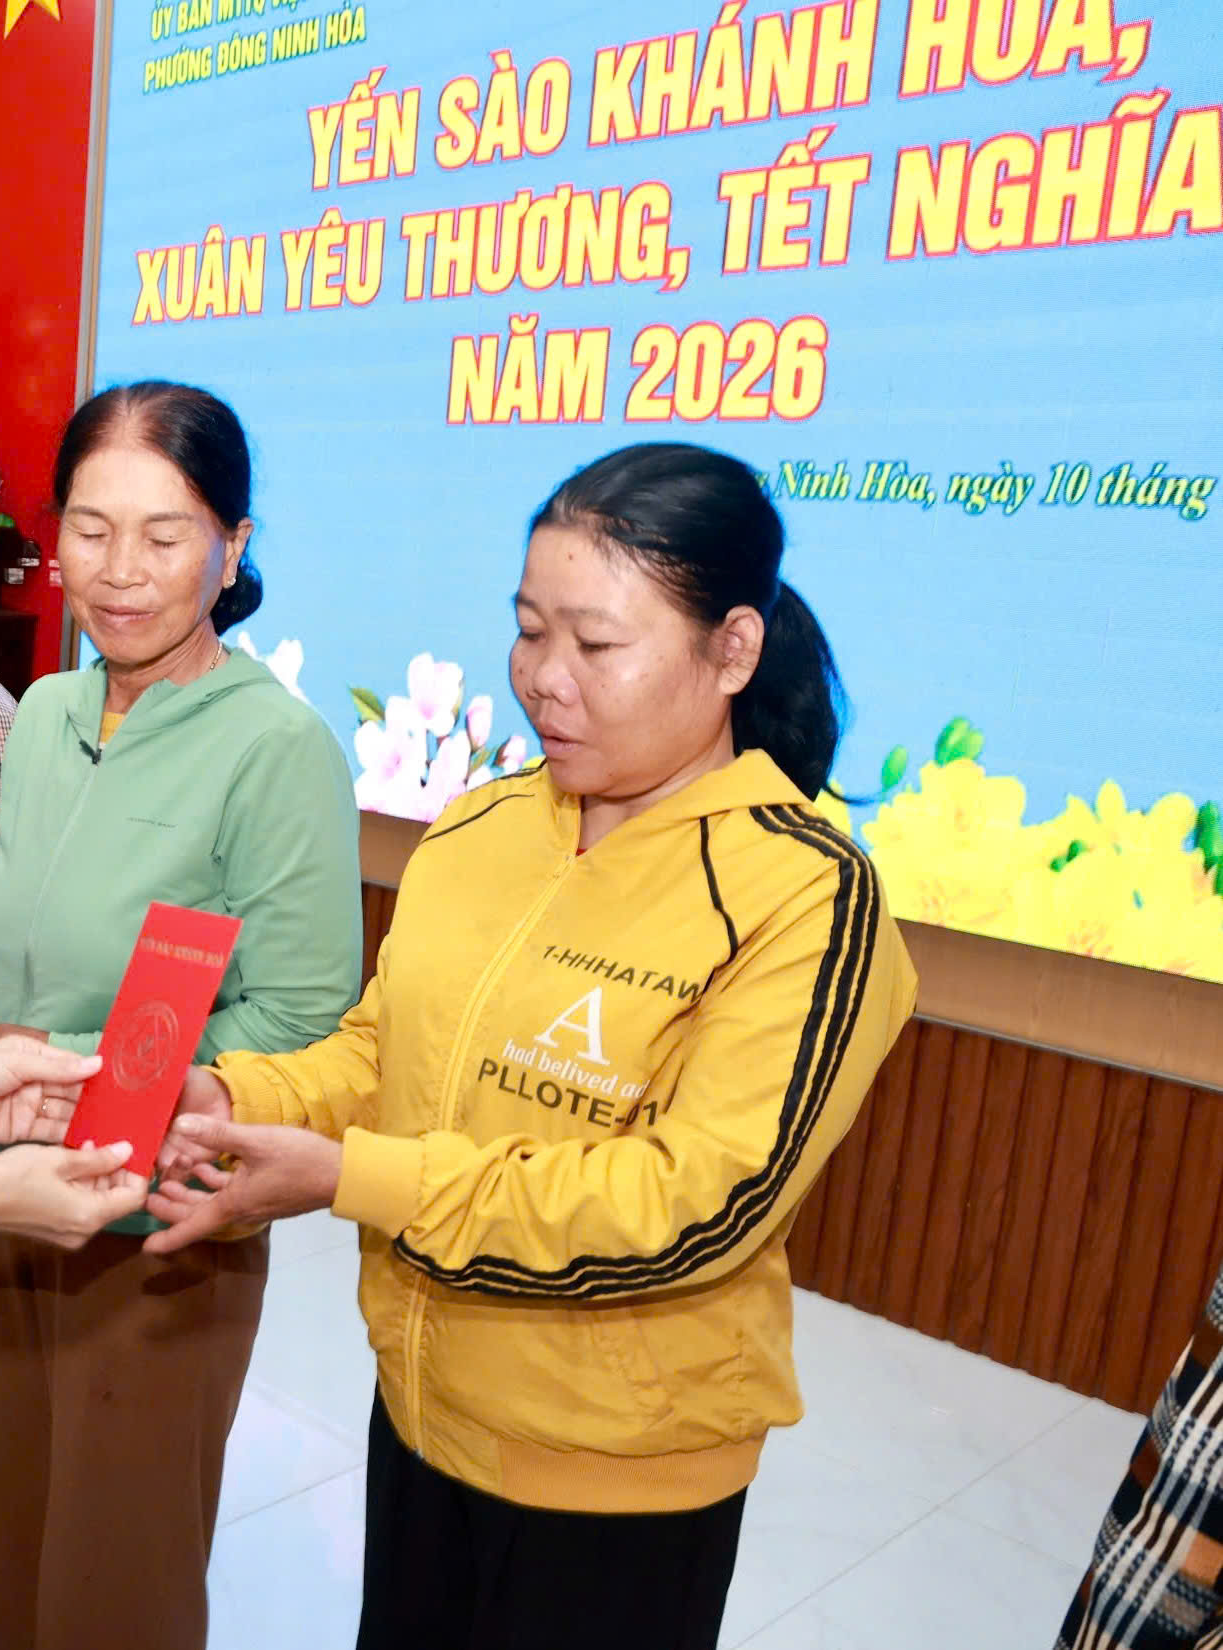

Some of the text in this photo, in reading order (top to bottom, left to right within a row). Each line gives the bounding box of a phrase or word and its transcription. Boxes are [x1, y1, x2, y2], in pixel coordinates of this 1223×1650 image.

[177, 0, 212, 35] BAN
[216, 31, 267, 76] ĐÔNG
[271, 17, 320, 63] NINH
[308, 67, 421, 190] YẾN
[434, 49, 571, 170] SÀO
[589, 0, 878, 147] KHÁNH
[132, 88, 1223, 325] XUÂN YÊU THƯƠNG, TẾT NGHĨA
[446, 312, 828, 425] NĂM 2026
[774, 459, 1216, 521] Ninh Hòa, ngày 10 tháng
[534, 984, 610, 1066] A
[502, 1039, 537, 1066] had
[538, 1051, 618, 1094] belived
